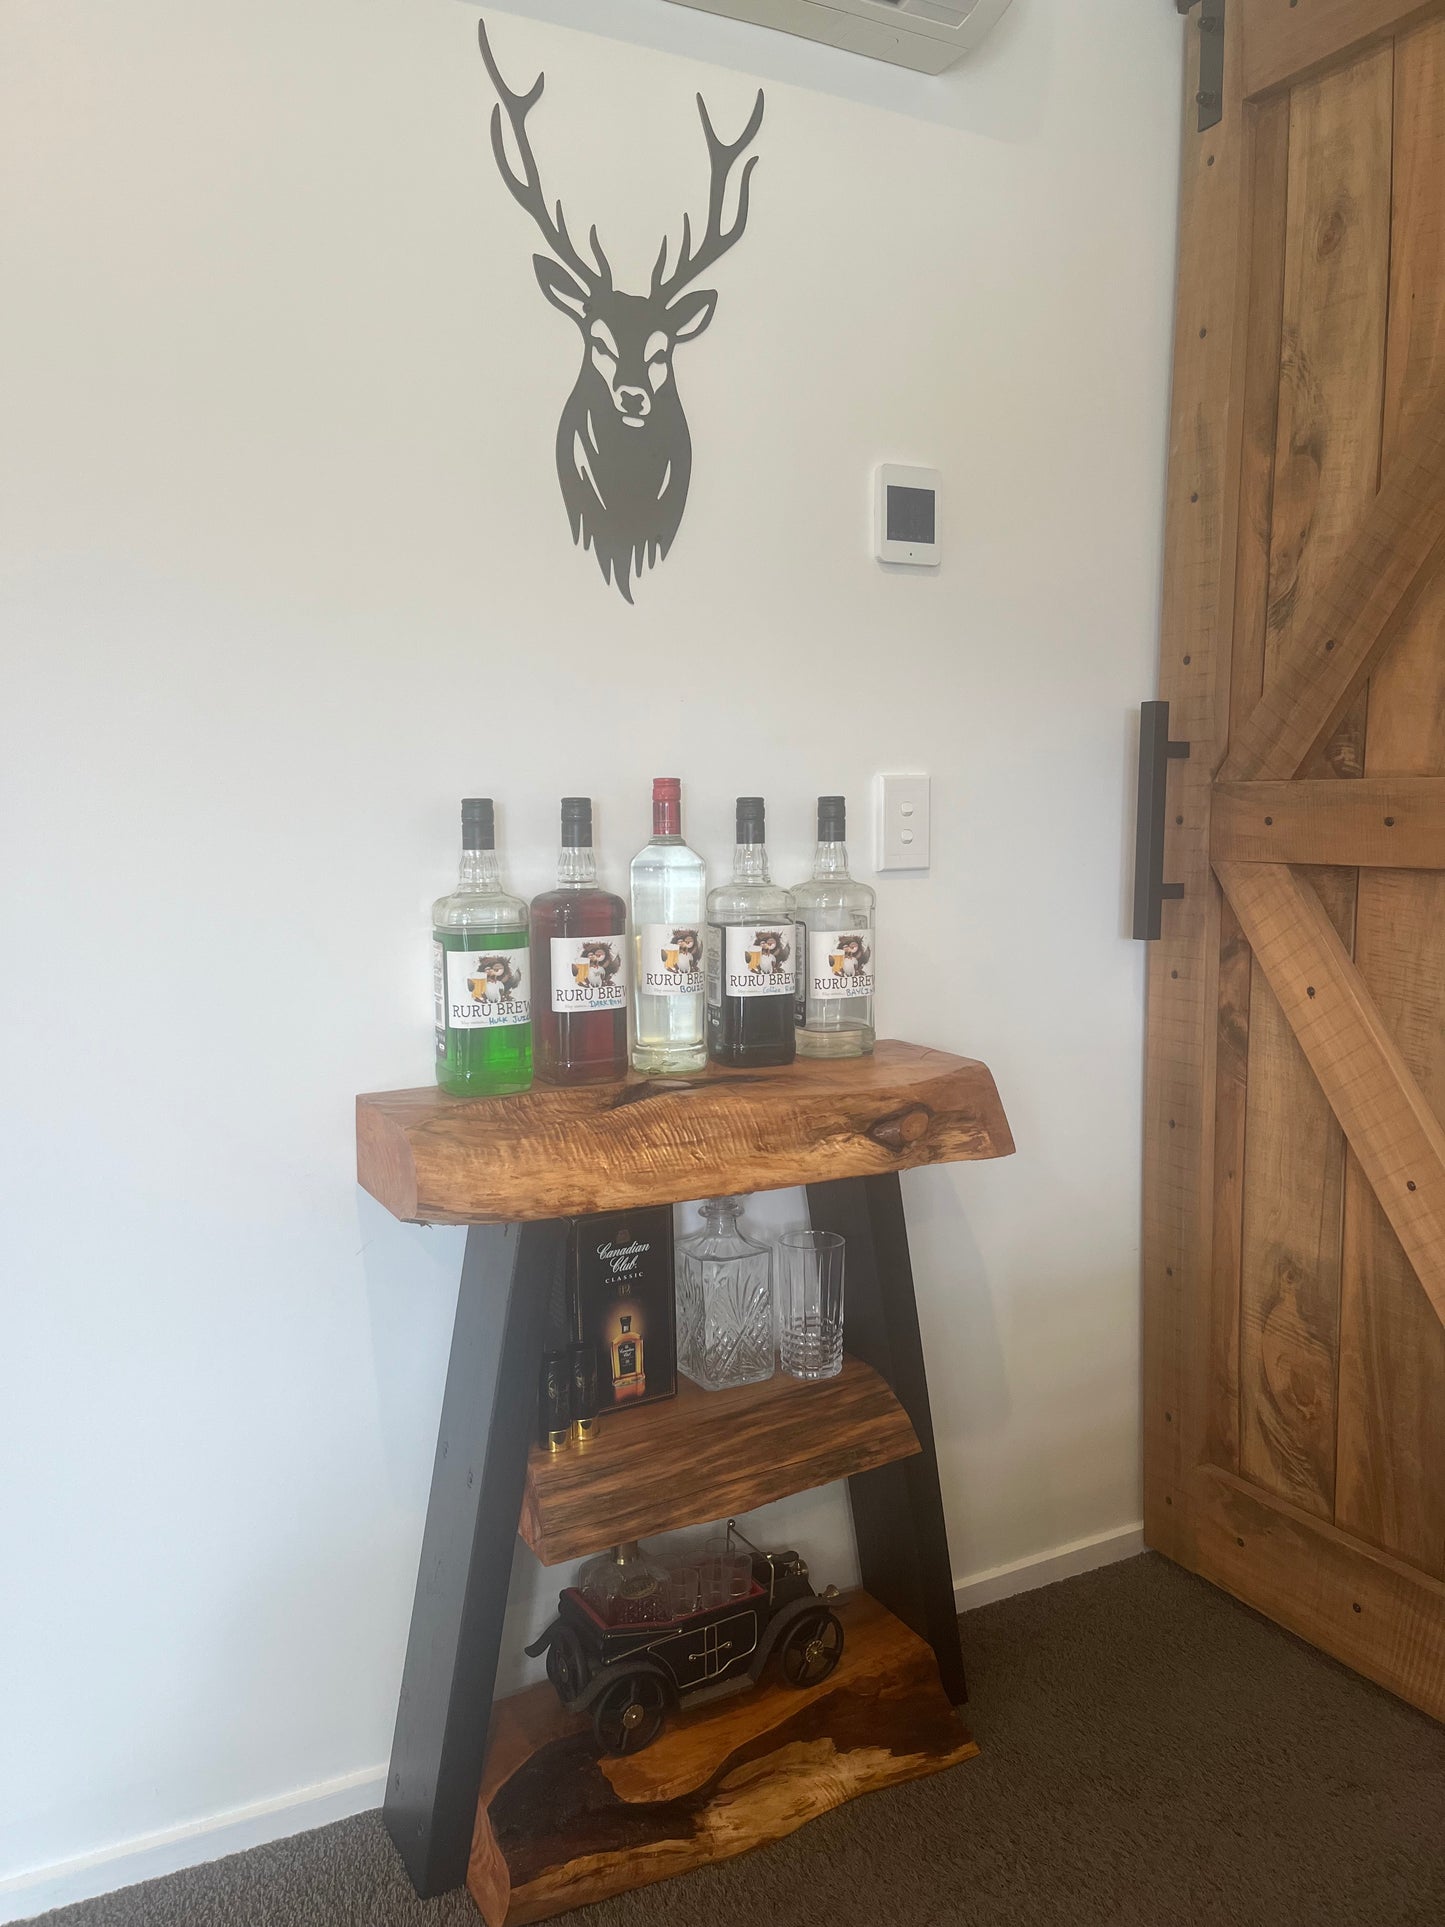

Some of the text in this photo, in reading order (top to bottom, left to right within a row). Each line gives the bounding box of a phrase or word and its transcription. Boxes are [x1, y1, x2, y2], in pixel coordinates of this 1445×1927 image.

[646, 973, 683, 986] RURU
[730, 974, 765, 987] RURU
[814, 977, 848, 990] RURU
[555, 988, 594, 1002] RURU
[452, 1004, 492, 1018] RURU
[488, 1016, 508, 1025] HULK
[596, 1240, 650, 1260] Canadian
[609, 1254, 639, 1273] Club
[604, 1271, 644, 1284] CLASSIC
